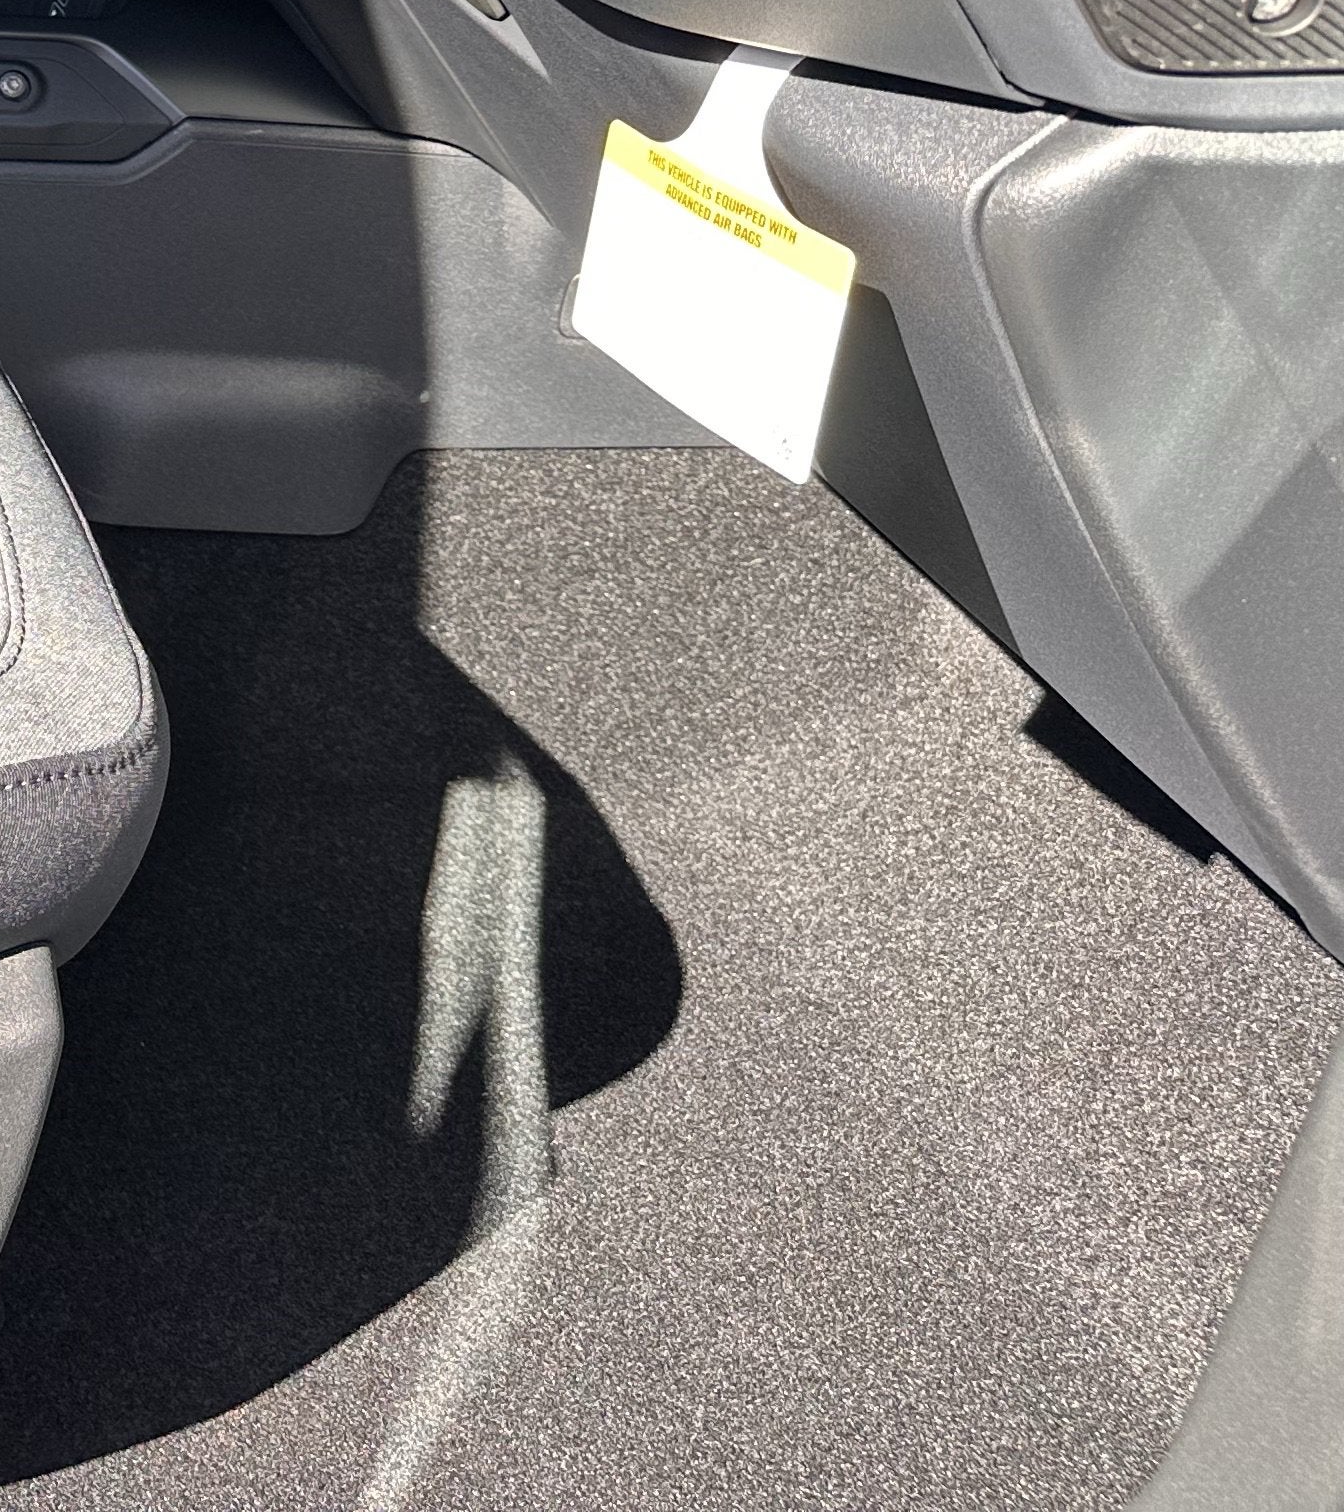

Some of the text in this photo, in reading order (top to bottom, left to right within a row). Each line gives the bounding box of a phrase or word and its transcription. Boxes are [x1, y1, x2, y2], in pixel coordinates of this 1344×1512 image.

[647, 149, 798, 245] THIS VEHICLE IS EQUIPPED WITH
[665, 183, 762, 248] ADVANCED AIR BAGS
